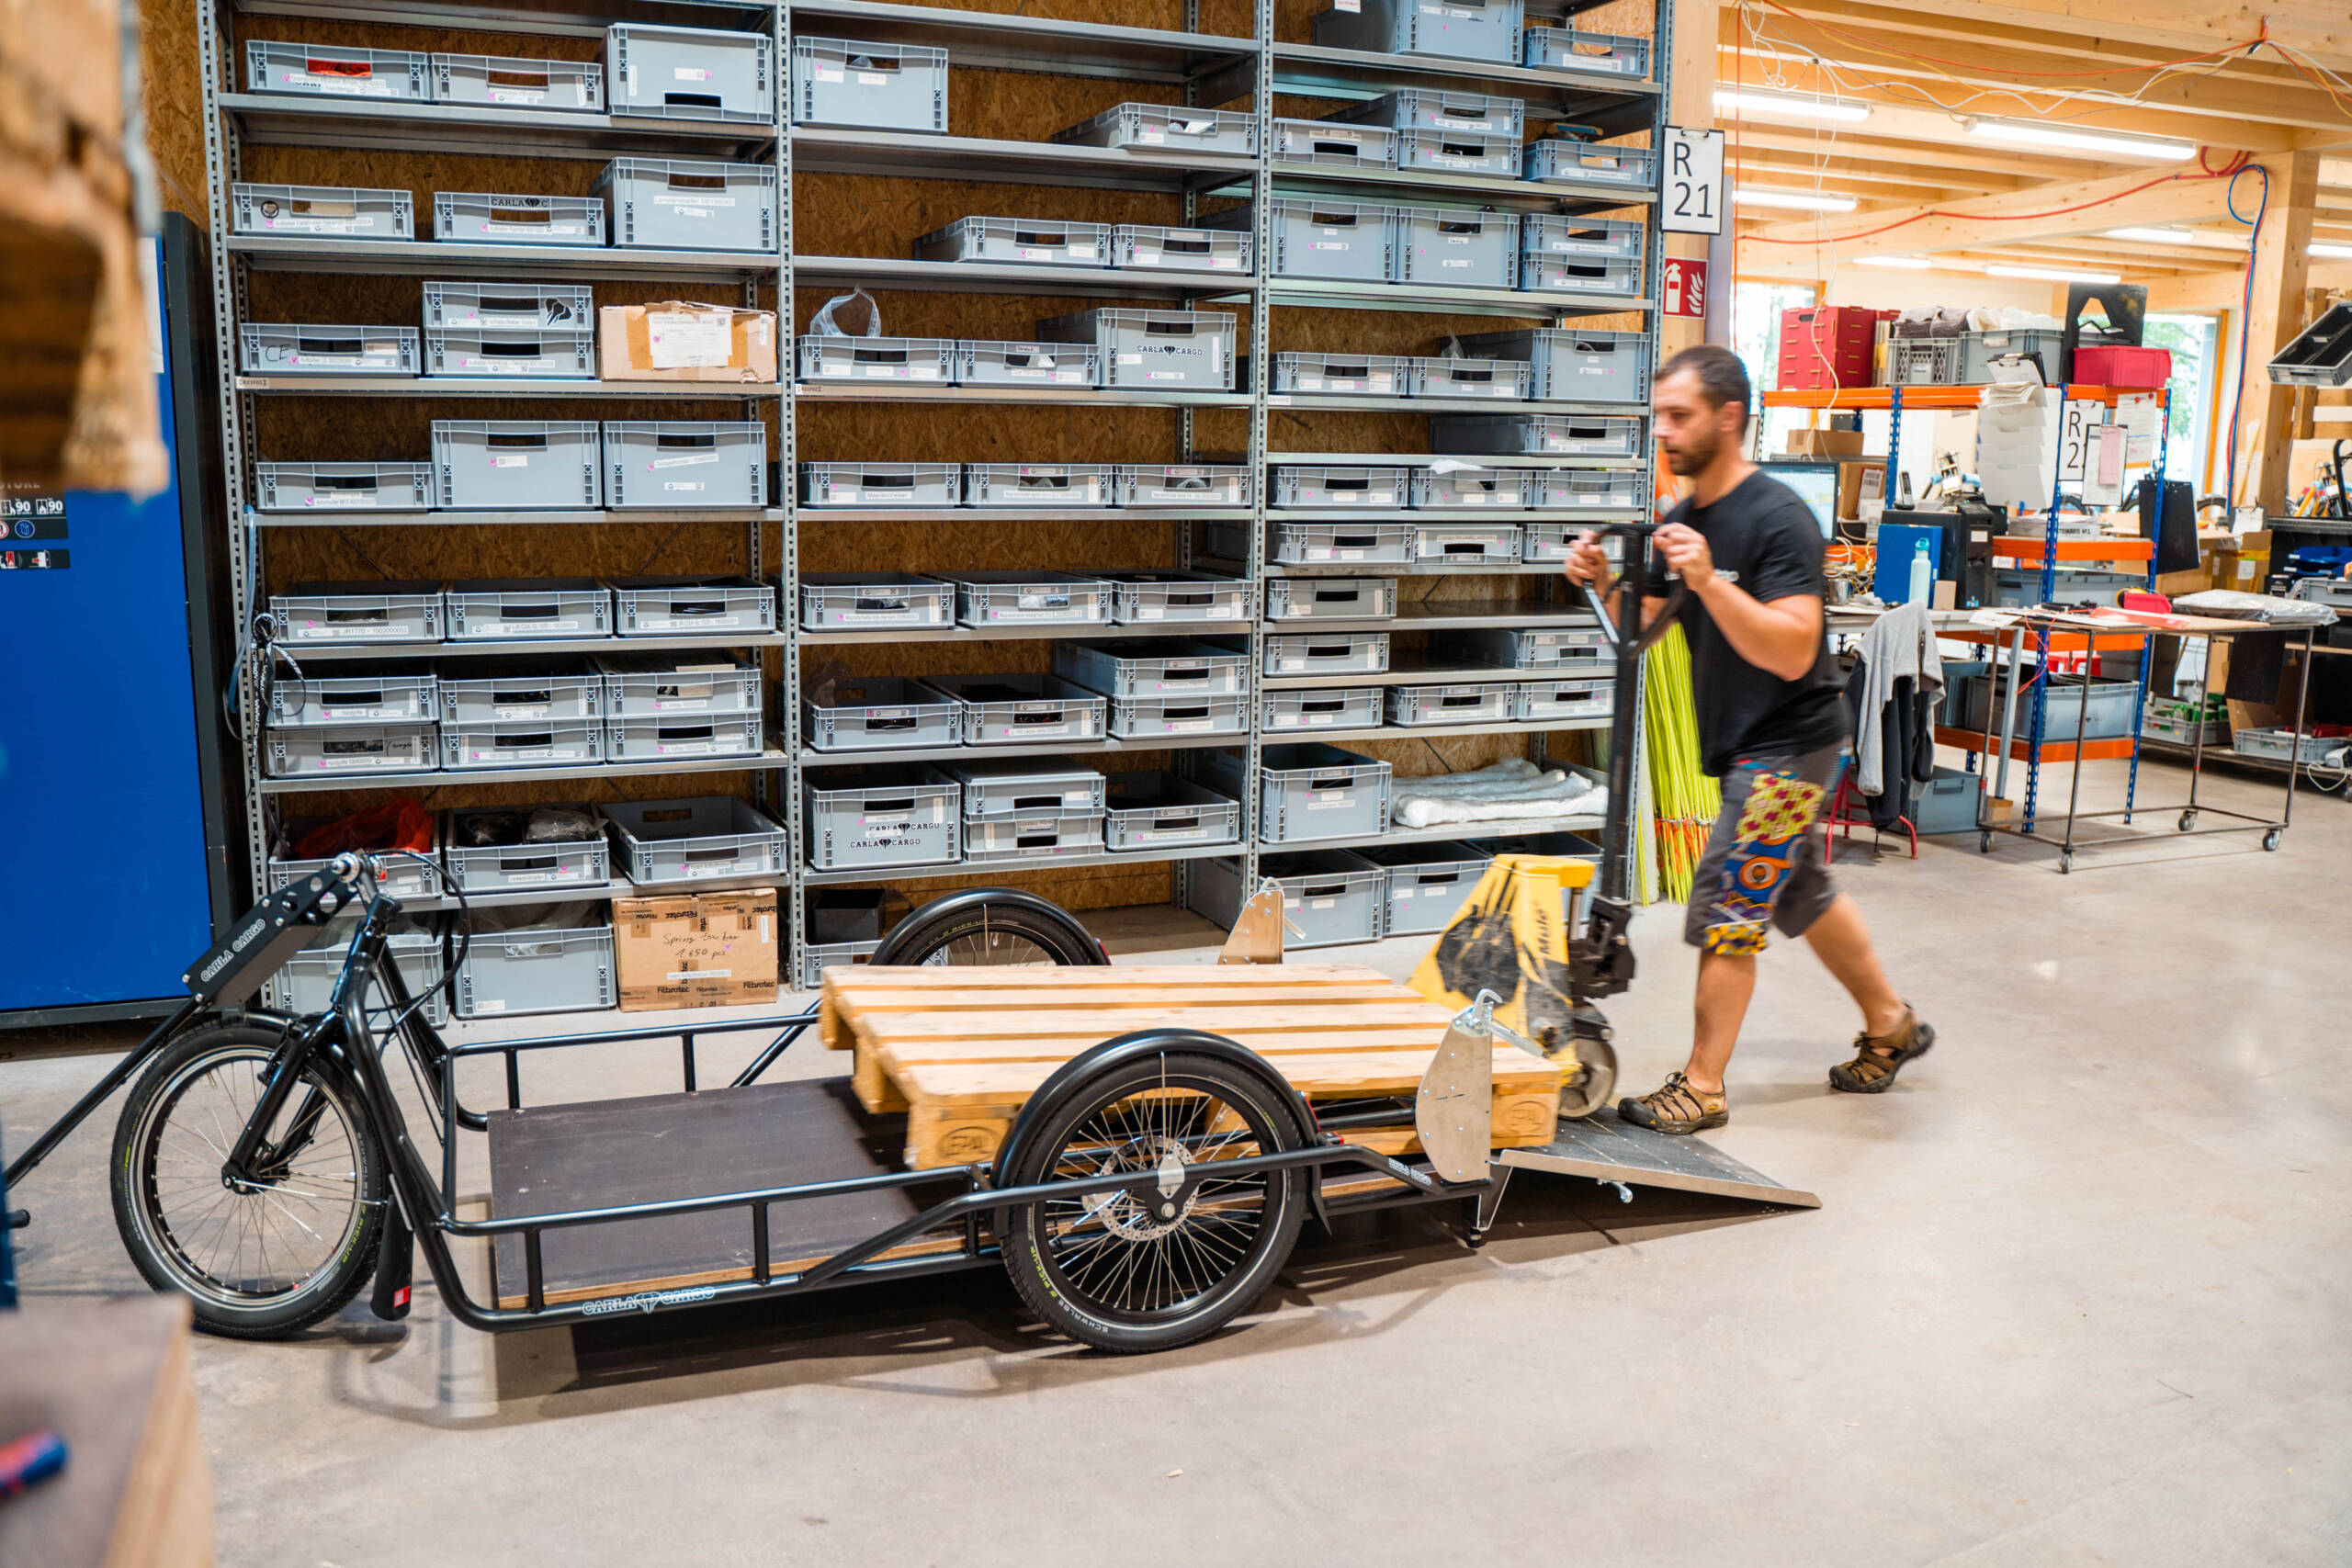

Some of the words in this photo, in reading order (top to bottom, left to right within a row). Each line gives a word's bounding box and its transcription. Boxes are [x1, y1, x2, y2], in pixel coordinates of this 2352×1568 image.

[1674, 141, 1692, 177] R
[491, 198, 525, 207] CARLA
[1674, 182, 1713, 219] 21
[265, 344, 291, 362] CE
[1136, 344, 1164, 355] CARLA
[1175, 346, 1203, 356] CARGO
[2068, 412, 2081, 438] R
[2067, 442, 2086, 469] 2
[16, 502, 31, 512] 90
[49, 501, 63, 512] 90
[910, 822, 940, 830] CARGO
[850, 840, 879, 849] CARLA
[891, 838, 921, 847] CARGO
[662, 933, 695, 946] Spring
[200, 949, 234, 983] CARLA
[232, 919, 266, 953] CARGO
[1030, 1246, 1051, 1288] PICK-UP
[582, 1296, 638, 1315] CARLA
[1058, 1299, 1109, 1333] SCHWALBE
